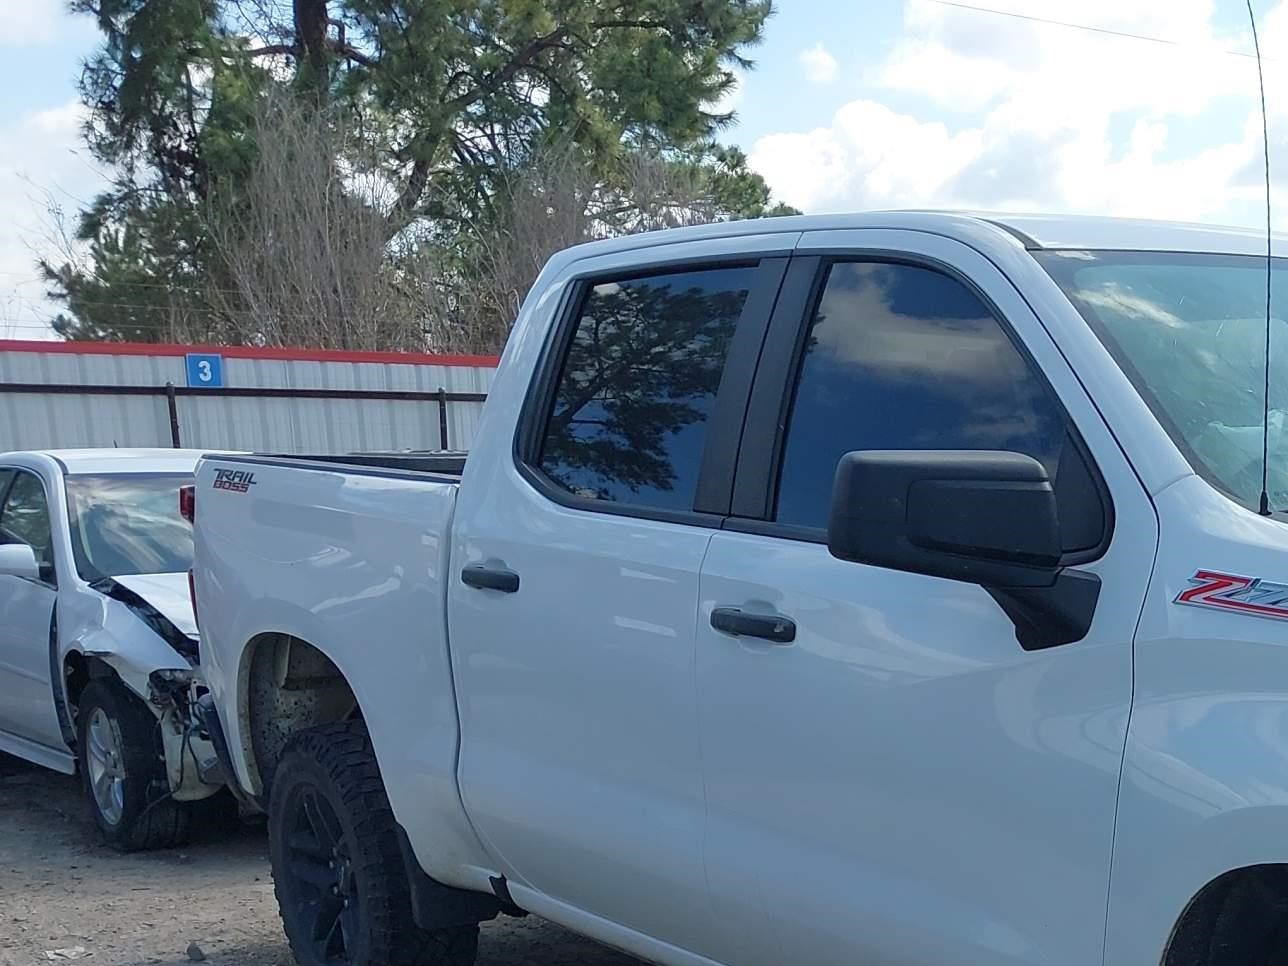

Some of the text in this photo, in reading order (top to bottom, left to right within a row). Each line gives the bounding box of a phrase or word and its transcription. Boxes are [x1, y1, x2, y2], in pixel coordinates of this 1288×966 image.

[199, 361, 212, 382] 3
[214, 468, 257, 485] TRAIL
[213, 479, 250, 493] BOSS
